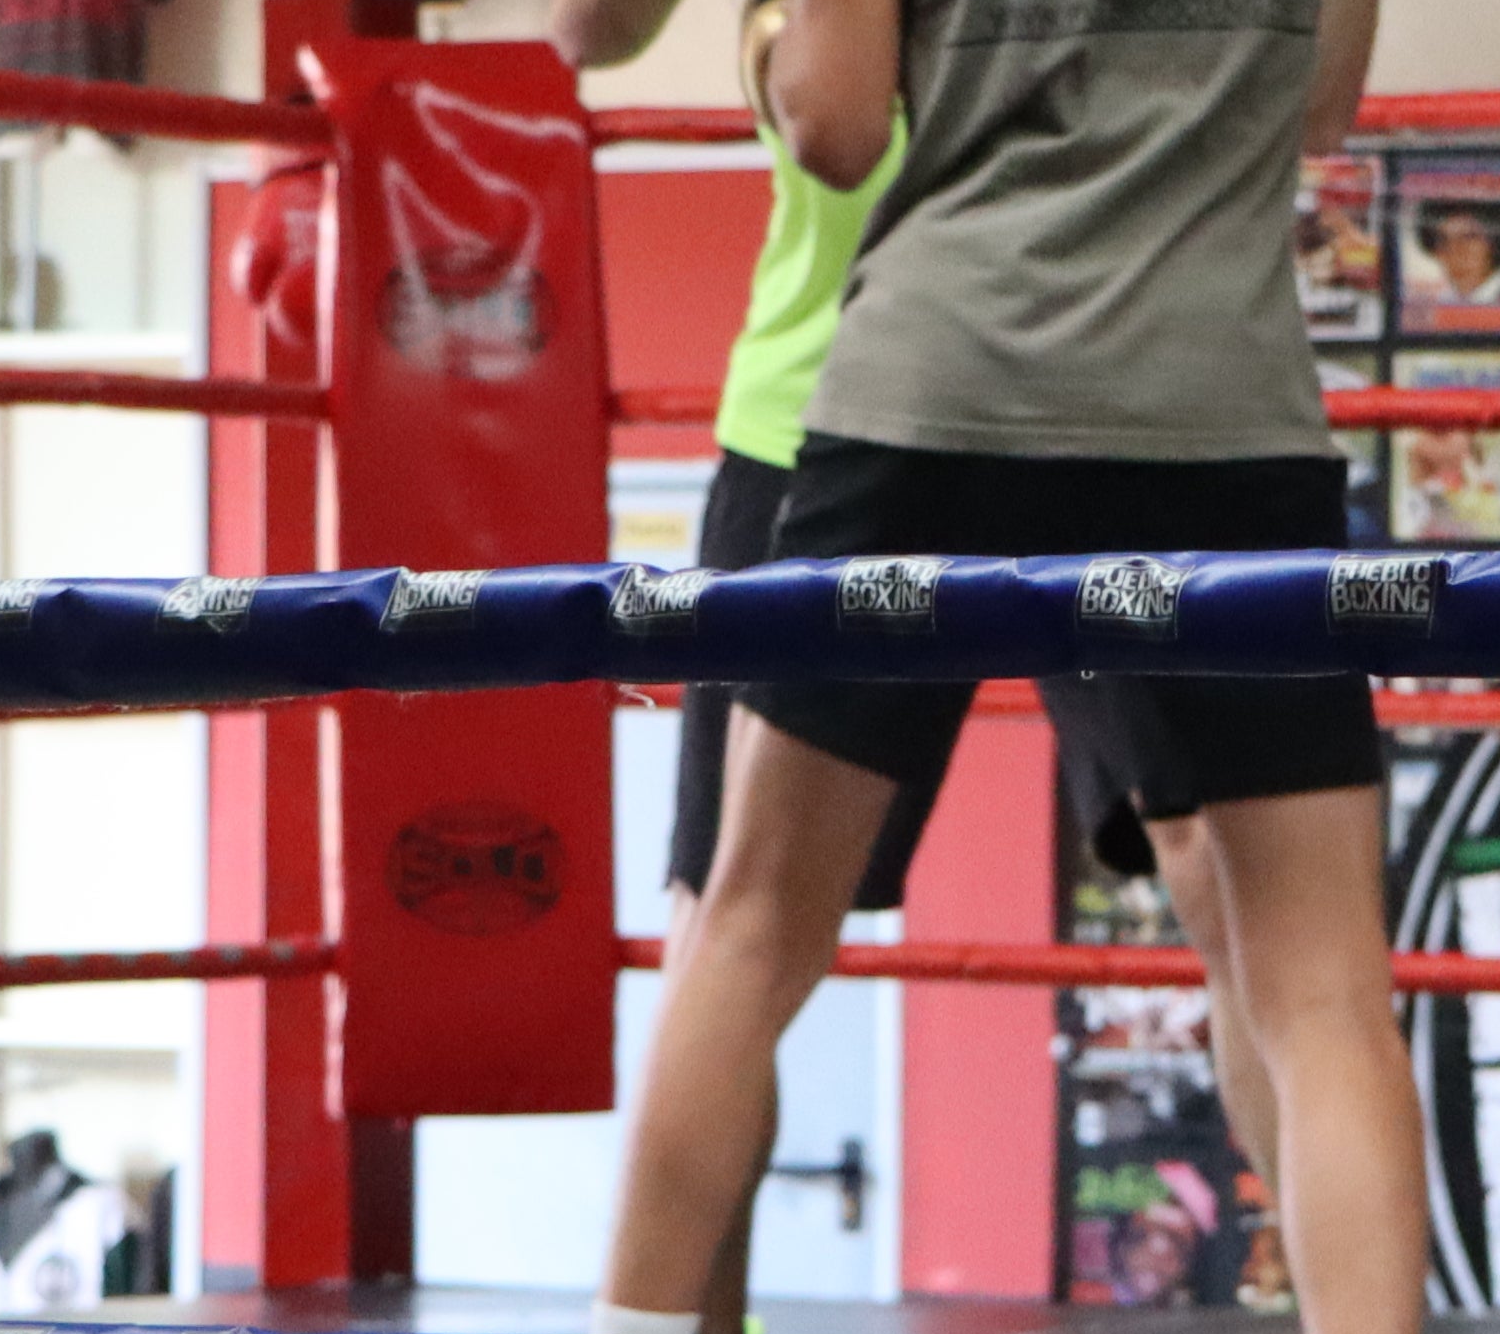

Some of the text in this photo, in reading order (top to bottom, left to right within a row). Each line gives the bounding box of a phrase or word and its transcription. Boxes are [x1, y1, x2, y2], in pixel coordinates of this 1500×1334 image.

[1337, 560, 1430, 582] PUEBLO
[844, 581, 932, 610] BOXING
[1083, 587, 1173, 616] BOXING
[1333, 582, 1429, 612] BOXING
